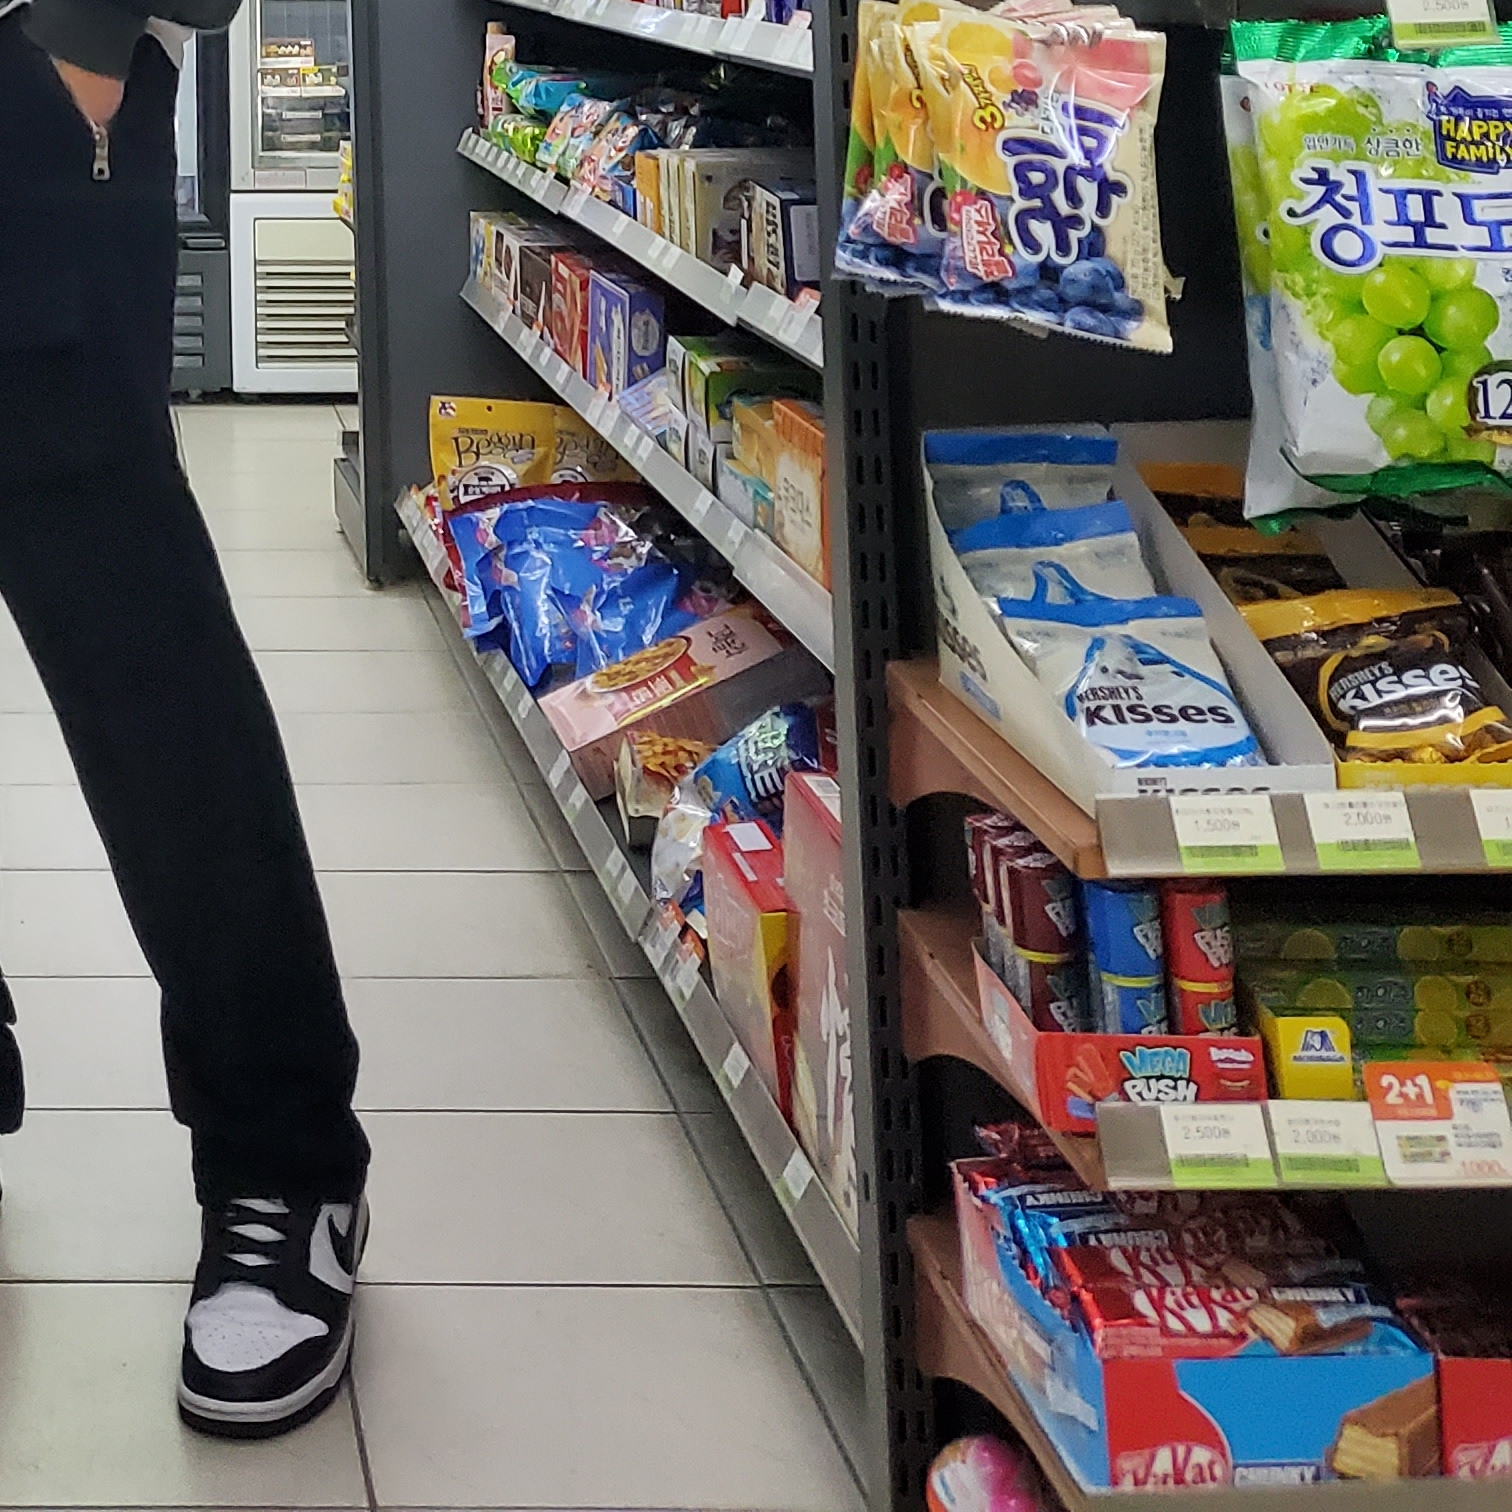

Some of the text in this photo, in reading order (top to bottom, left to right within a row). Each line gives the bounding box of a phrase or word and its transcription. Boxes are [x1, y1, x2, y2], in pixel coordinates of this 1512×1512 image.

[1363, 136, 1422, 159] 상큼한
[1077, 685, 1144, 705] HERSHEY'S
[1087, 702, 1236, 727] KISSES
[1122, 1078, 1198, 1103] PUSH
[1379, 1073, 1434, 1105] 2+1
